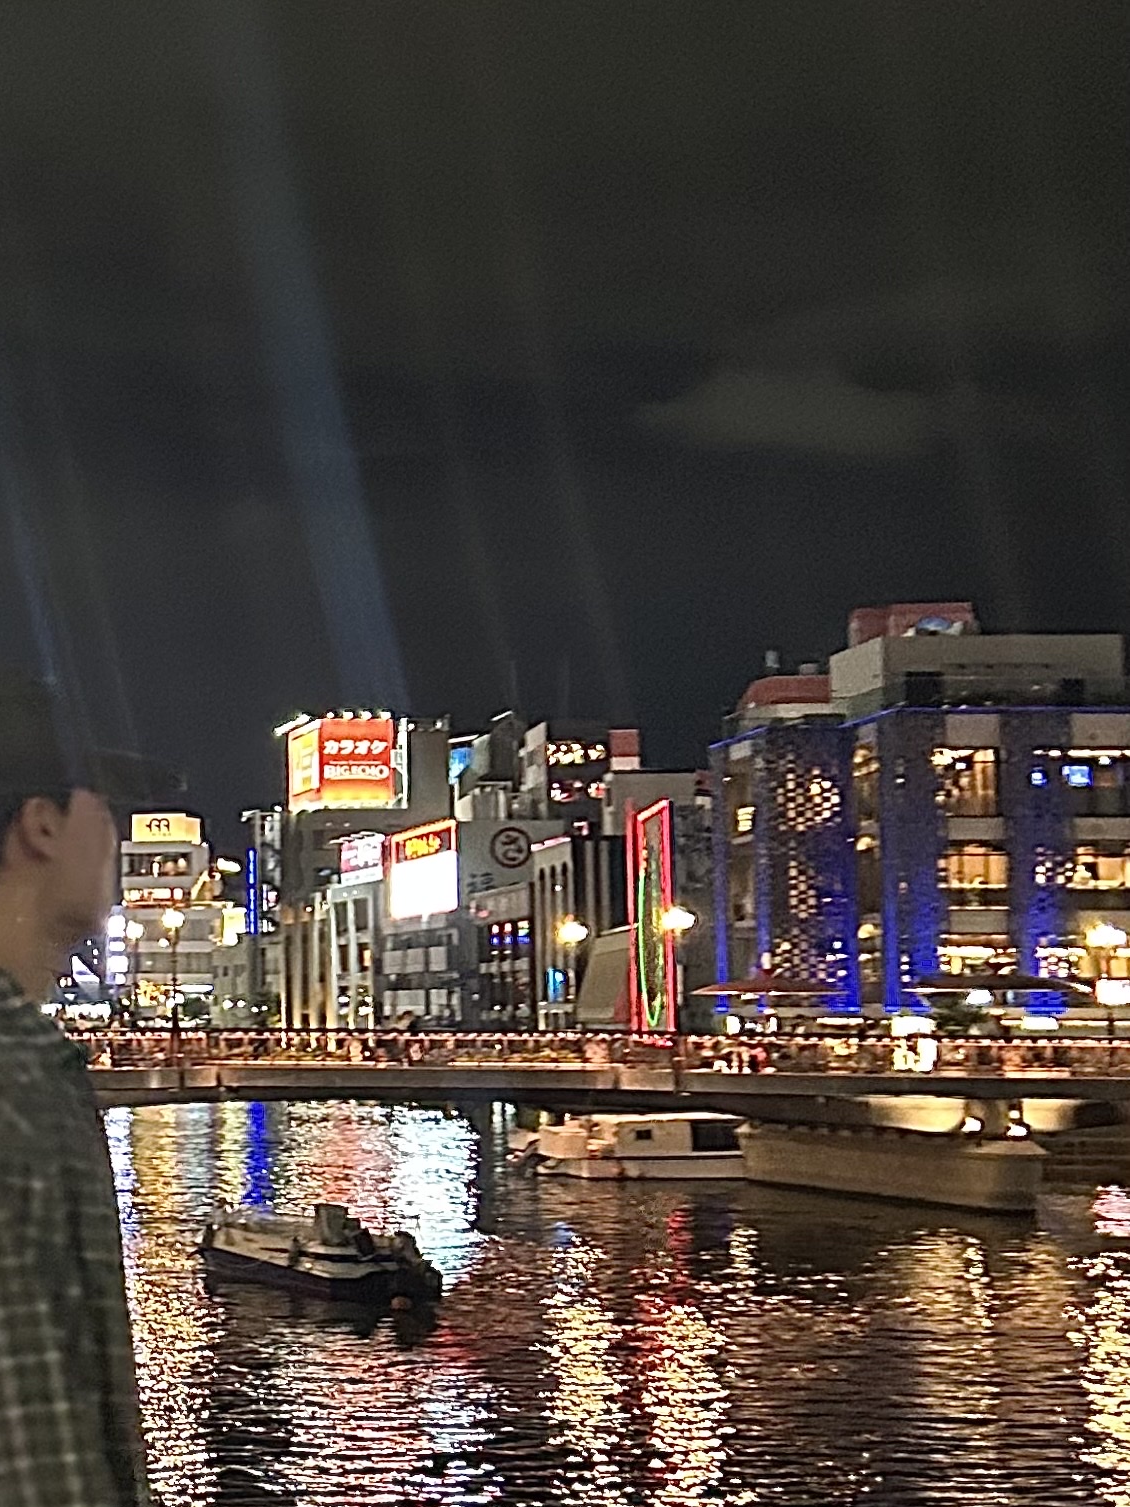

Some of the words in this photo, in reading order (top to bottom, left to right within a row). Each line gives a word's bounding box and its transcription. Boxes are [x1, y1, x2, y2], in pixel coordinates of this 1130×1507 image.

[323, 739, 389, 755] カラオケ
[323, 764, 350, 780] BIG
